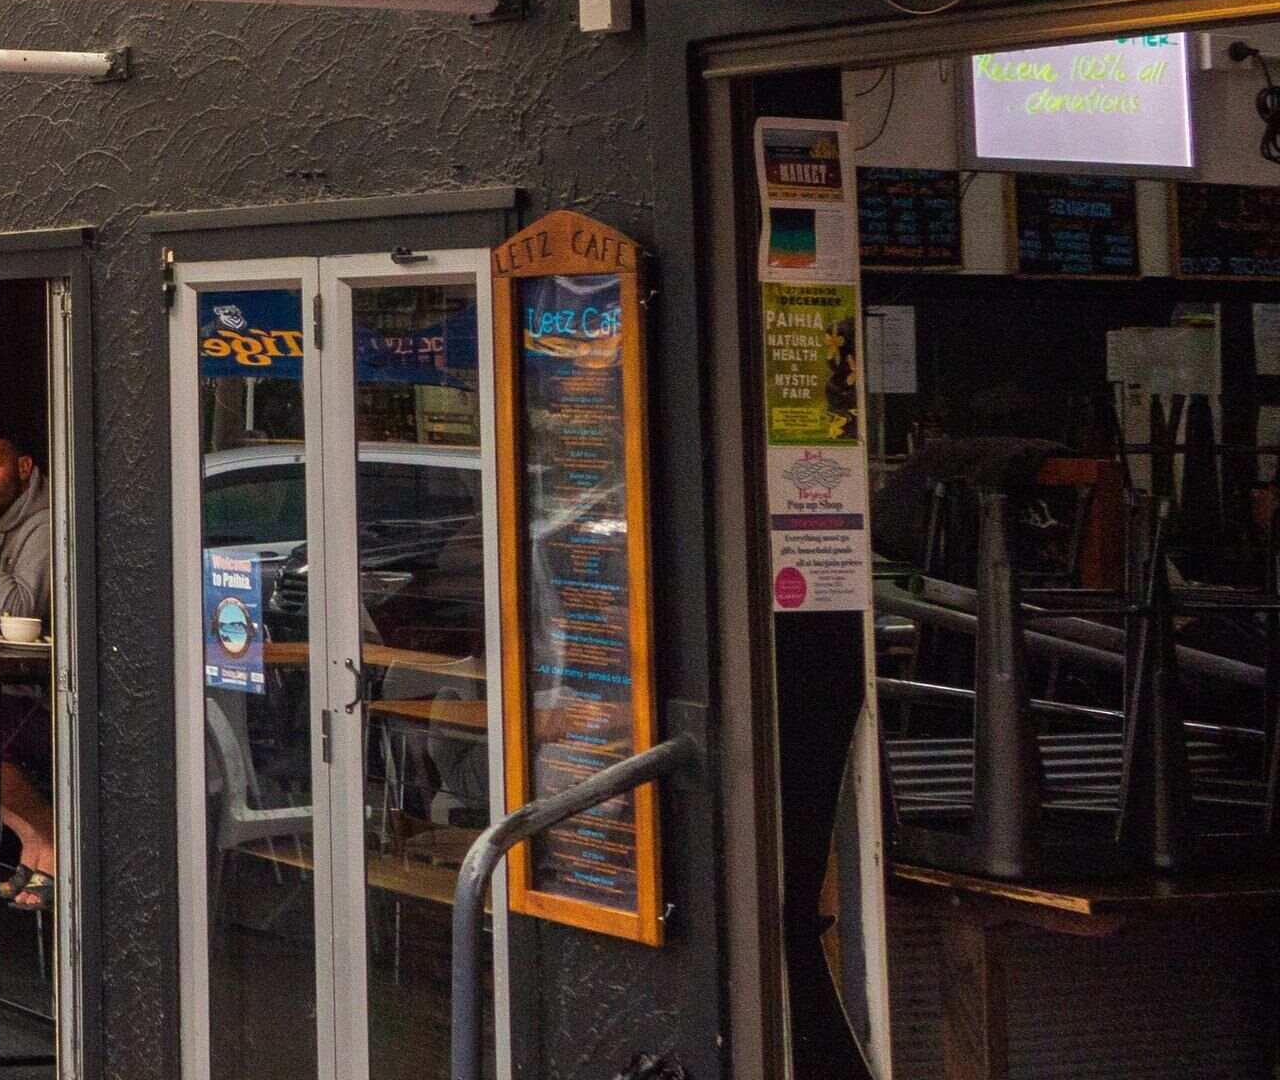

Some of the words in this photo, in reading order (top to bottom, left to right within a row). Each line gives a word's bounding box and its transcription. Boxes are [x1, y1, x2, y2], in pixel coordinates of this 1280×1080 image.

[1069, 52, 1130, 83] 100%
[779, 163, 828, 185] MARKET
[494, 230, 553, 274] LETZ
[570, 229, 629, 267] CAFE
[780, 296, 842, 306] DECEMBER
[527, 307, 577, 338] Letz
[581, 306, 622, 338] Caf
[765, 310, 824, 330] PAIHIA
[767, 334, 822, 347] NATURAL
[772, 350, 818, 362] HEALTH
[774, 374, 819, 387] MYSTIC
[782, 387, 812, 399] FAIR
[212, 572, 222, 587] to
